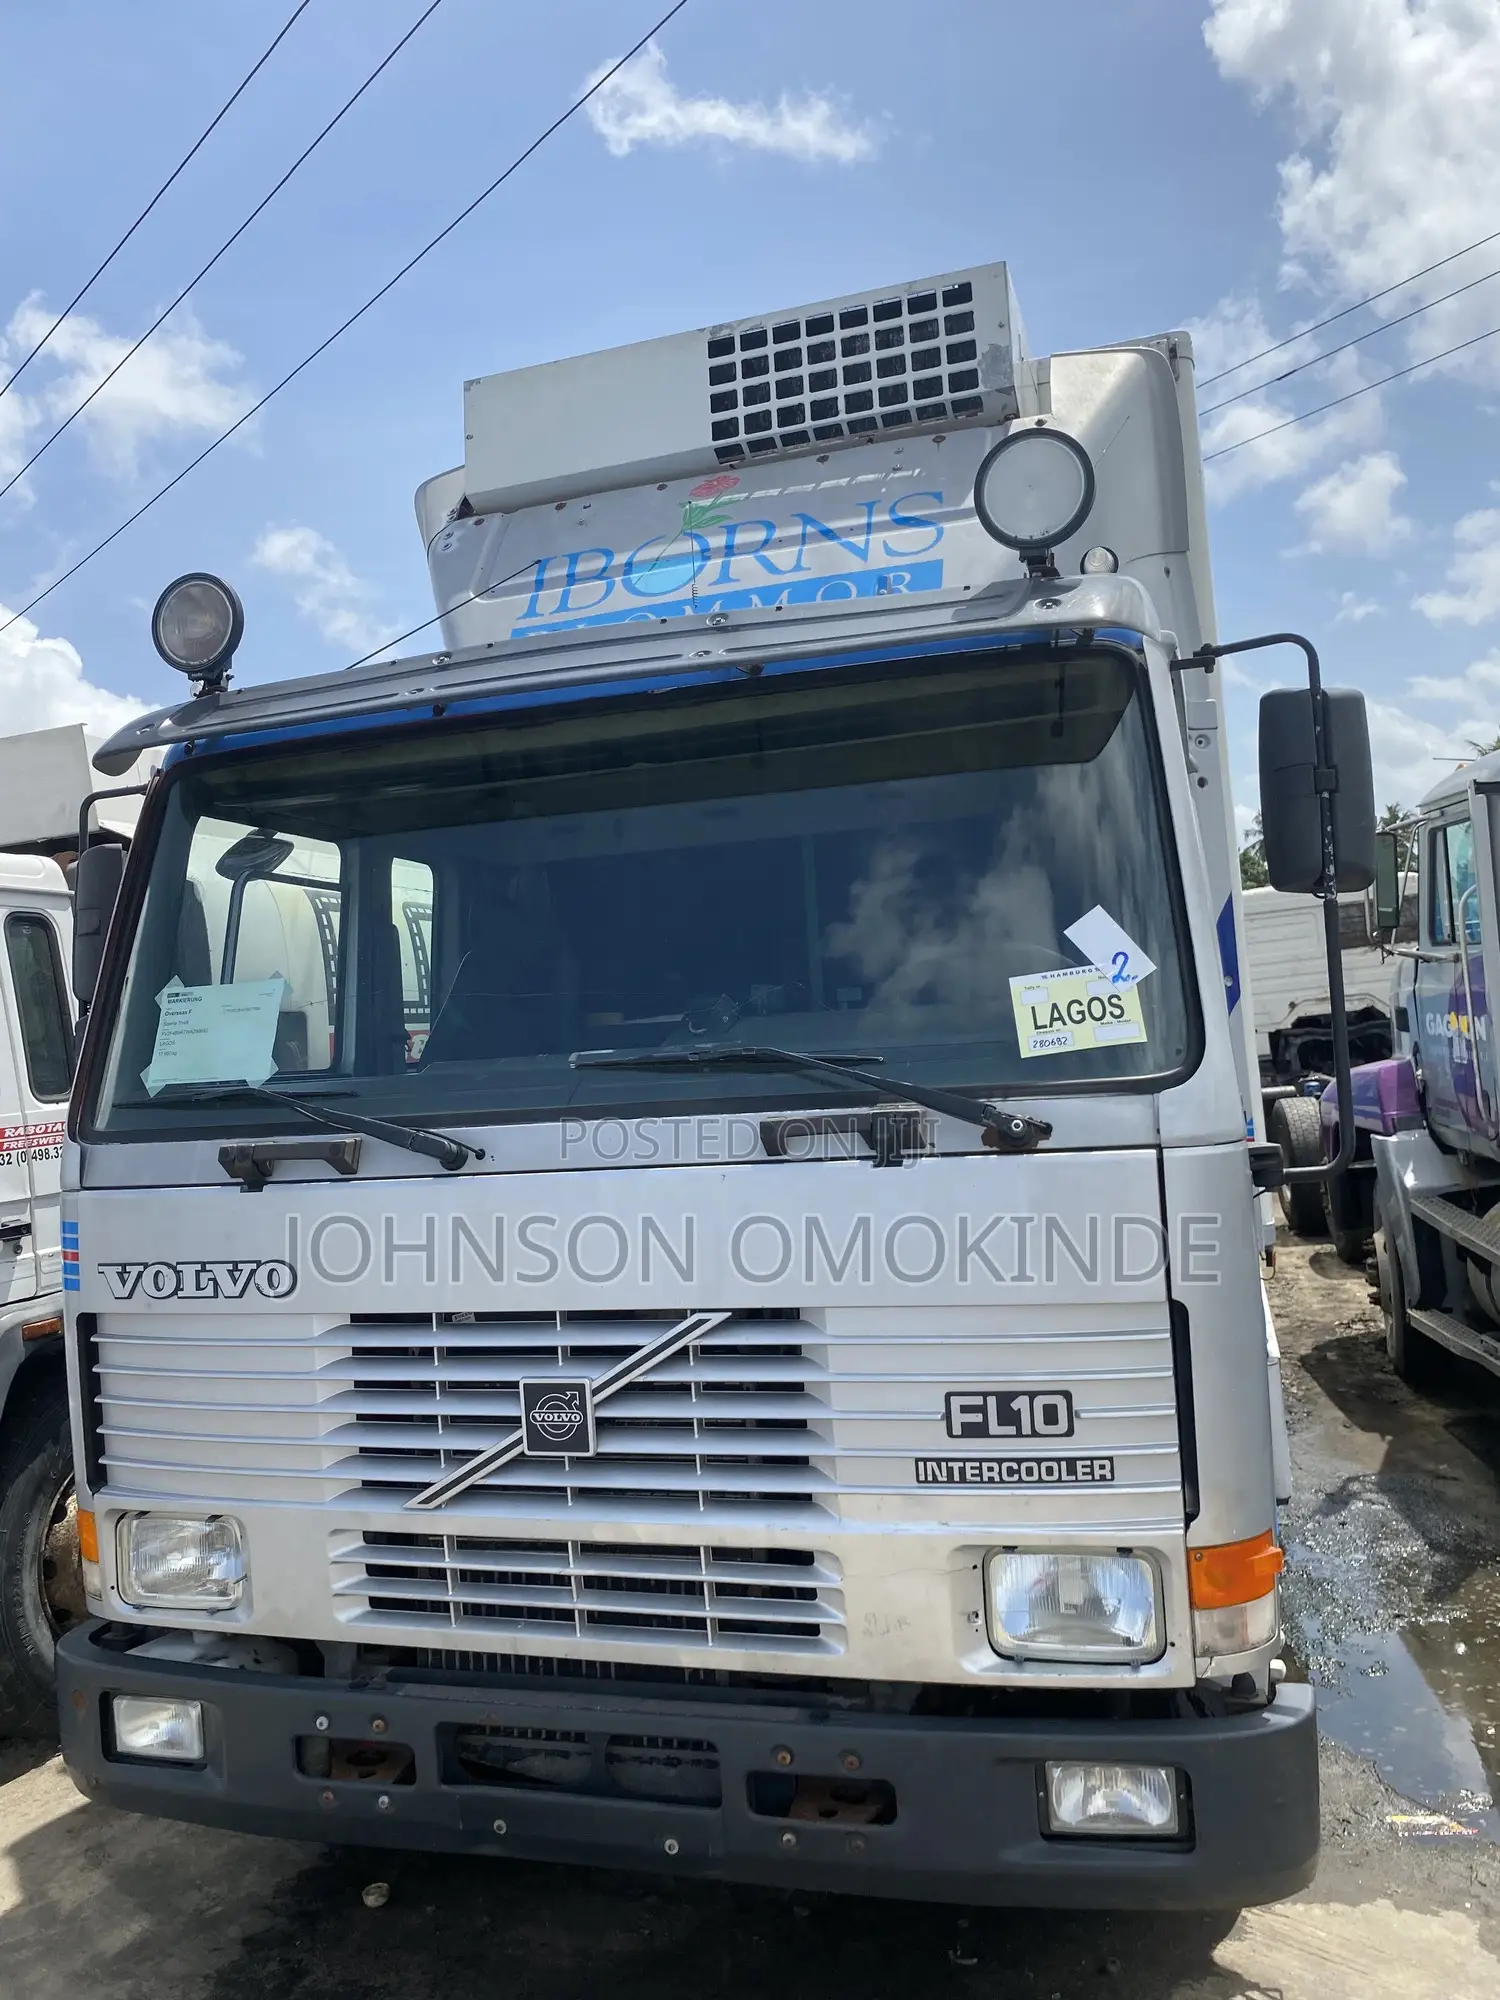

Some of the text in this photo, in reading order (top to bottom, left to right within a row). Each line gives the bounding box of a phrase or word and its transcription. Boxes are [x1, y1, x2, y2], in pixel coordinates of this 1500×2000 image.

[1050, 968, 1093, 979] HAMBURG
[1031, 994, 1125, 1031] LAGOS
[1032, 1036, 1068, 1049] 280682
[4, 1122, 66, 1138] RABOTA
[97, 1259, 297, 1300] VOLVO
[533, 1412, 581, 1422] VOLVO
[949, 1394, 1069, 1436] FL10
[917, 1459, 1112, 1482] INTERCOOLER
